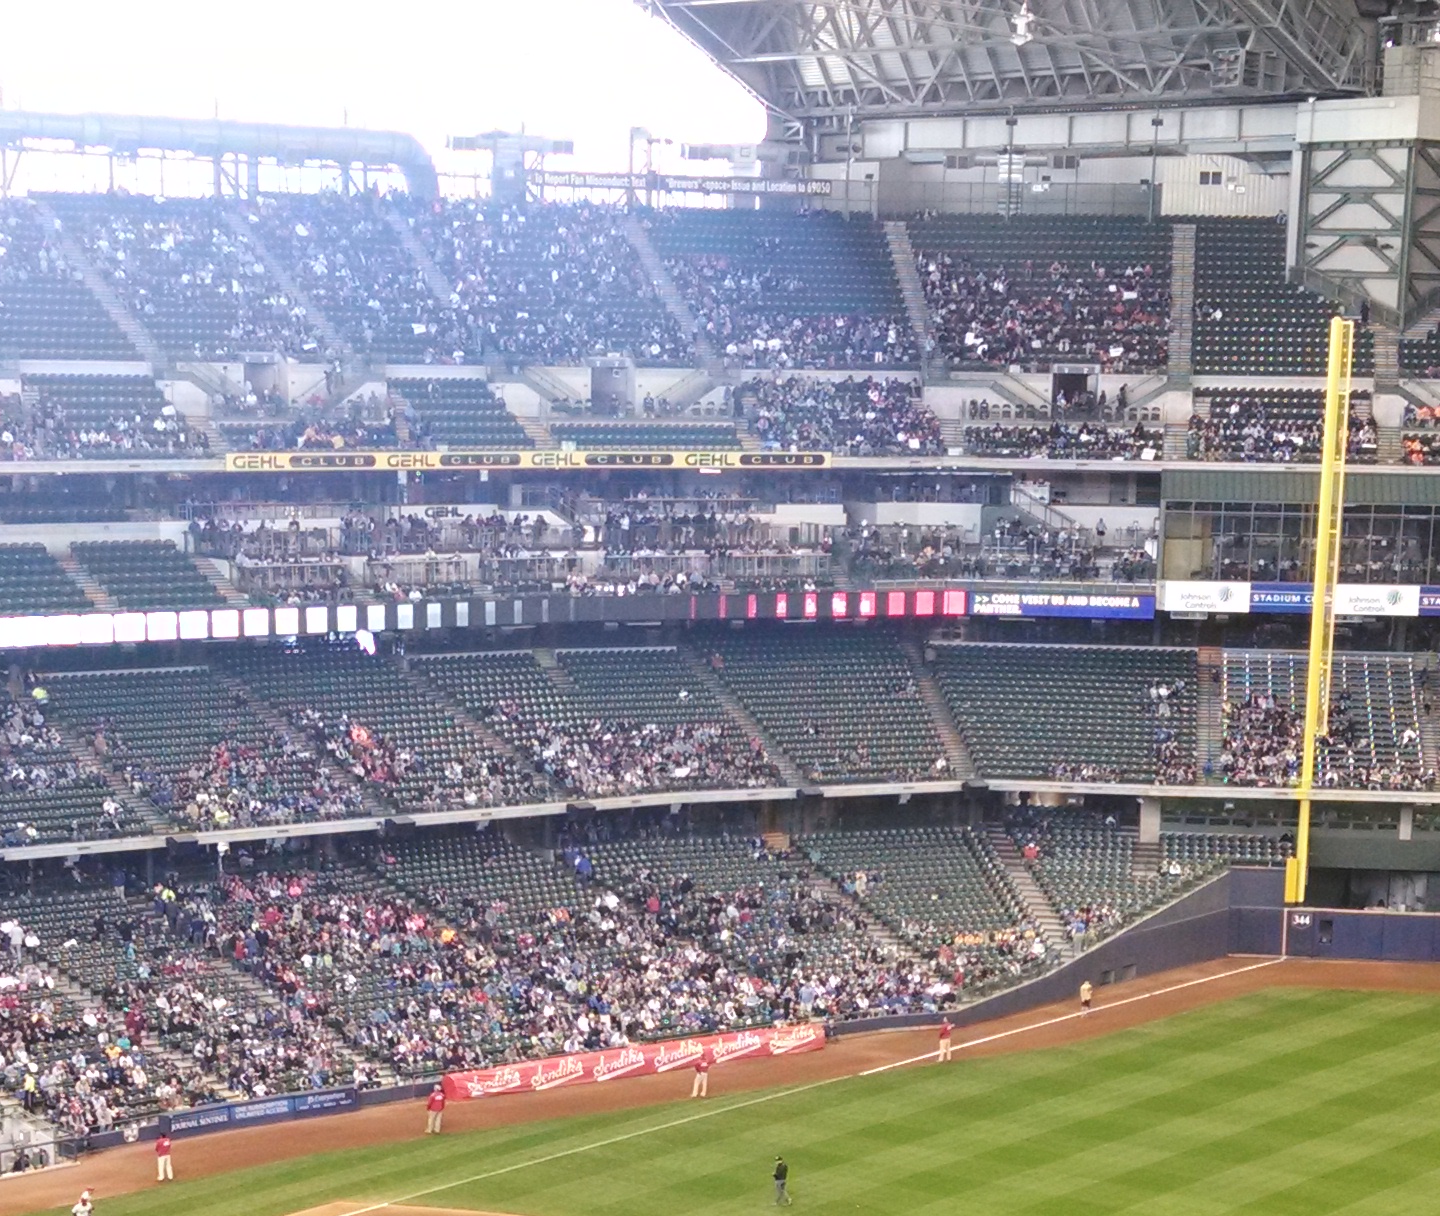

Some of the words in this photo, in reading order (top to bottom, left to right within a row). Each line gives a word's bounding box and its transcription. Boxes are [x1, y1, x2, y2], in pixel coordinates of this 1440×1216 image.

[544, 173, 569, 184] Report
[570, 174, 584, 184] Fan
[631, 175, 646, 187] Text
[751, 180, 765, 192] and
[766, 180, 797, 192] Location
[232, 455, 285, 469] GEHL
[301, 456, 364, 465] CLUB
[387, 454, 435, 467] GEHL
[451, 455, 510, 465] CLUB
[531, 453, 580, 466] GEHL
[597, 455, 662, 464] CLUB
[685, 453, 735, 466] GEHL
[751, 455, 814, 464] CLUB
[424, 506, 464, 518] GEHL
[1180, 593, 1212, 603] Johnson
[1253, 593, 1301, 603] STADIUM
[1348, 595, 1381, 605] Johnson
[1184, 600, 1217, 610] Controls
[1353, 603, 1385, 612] Controls
